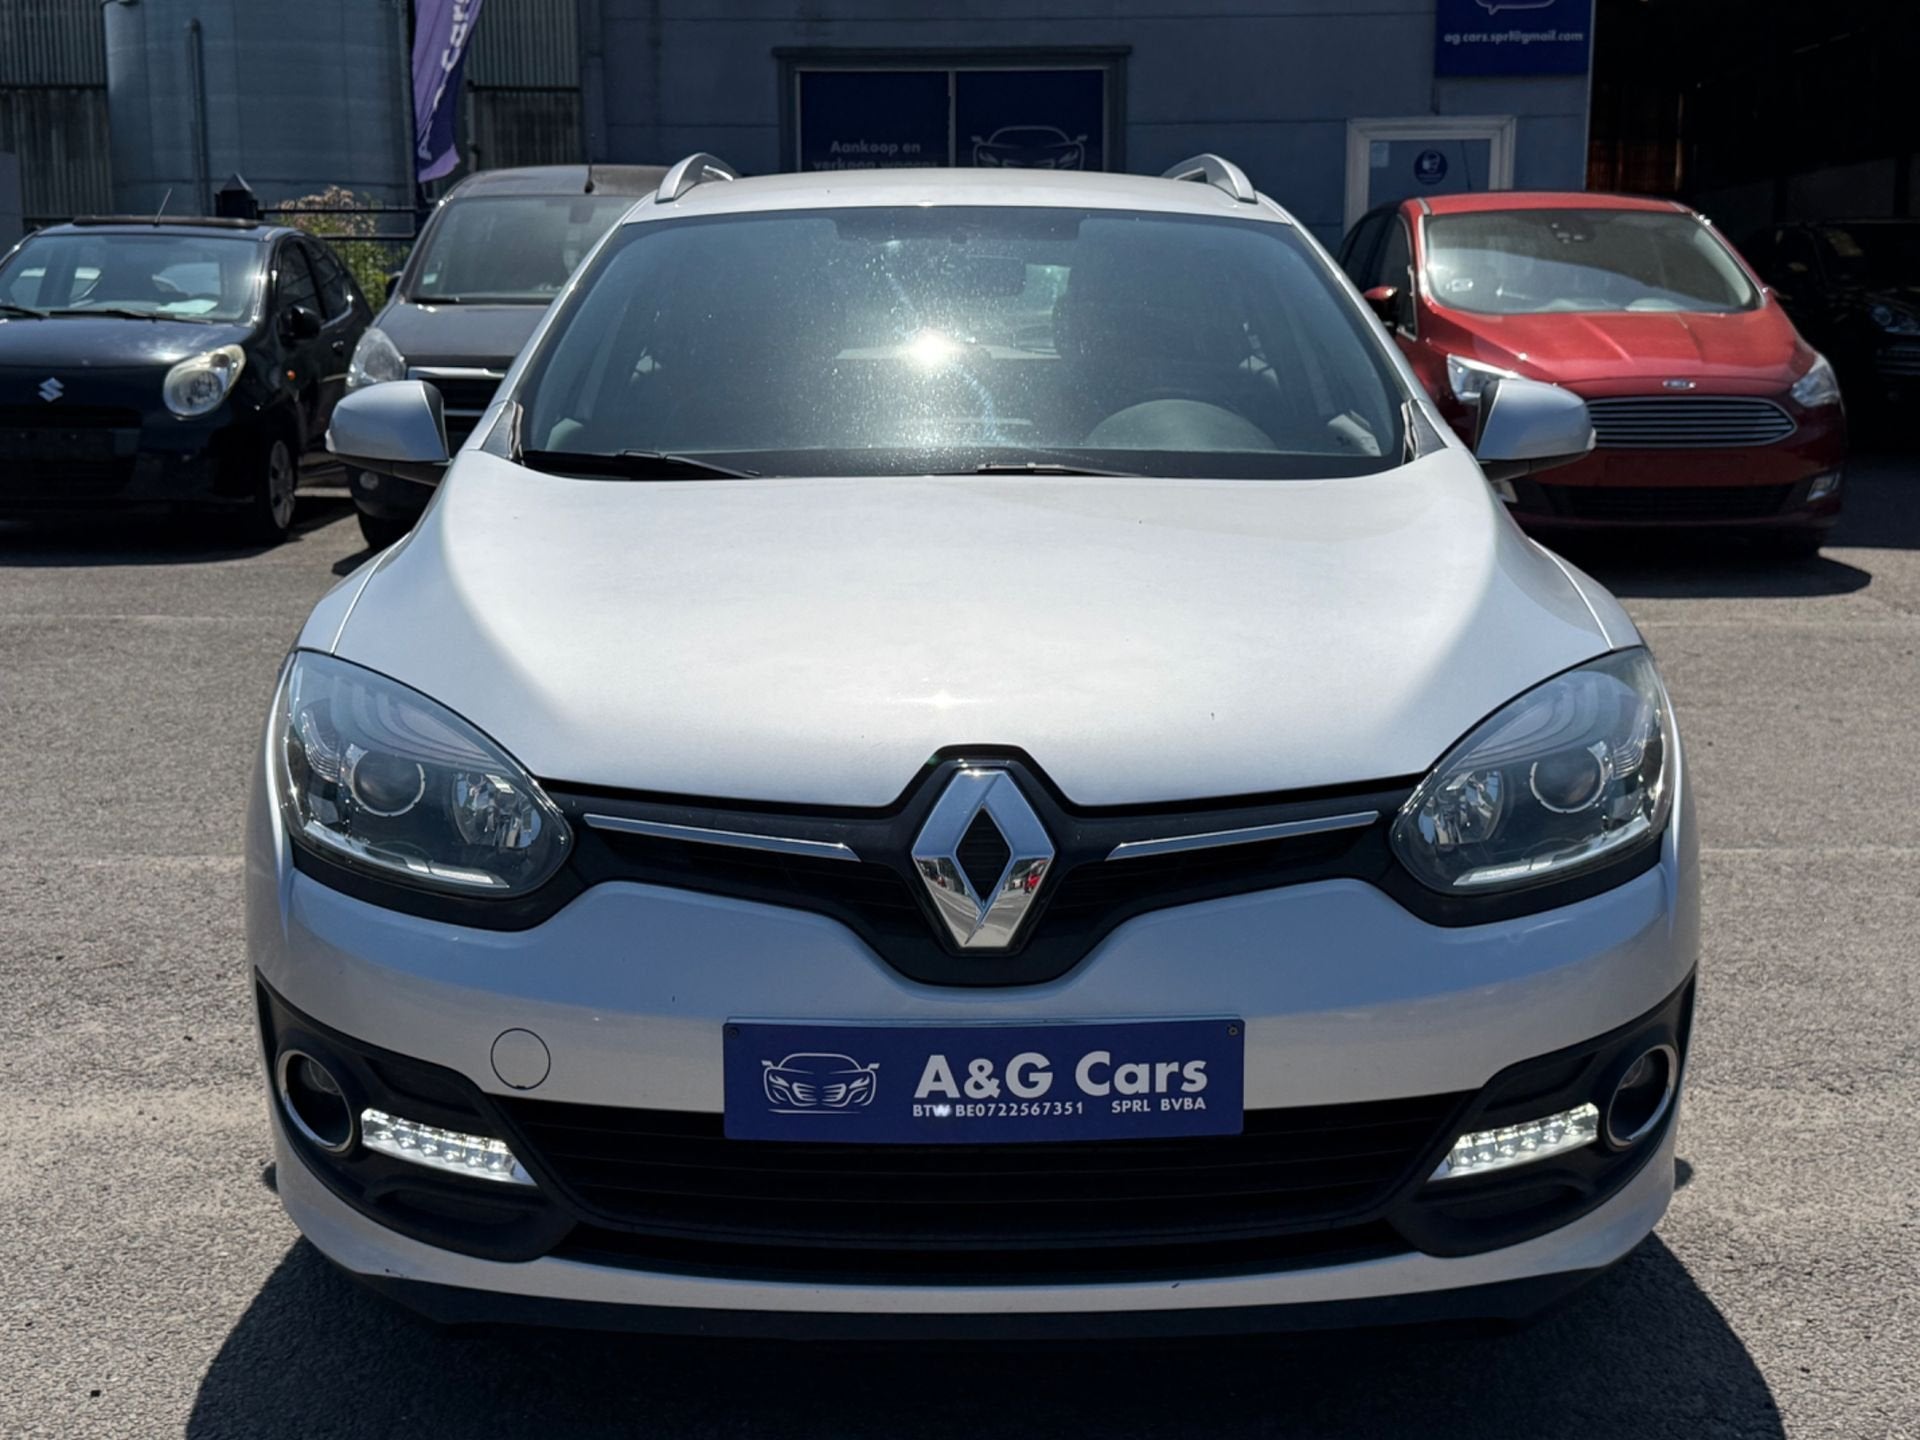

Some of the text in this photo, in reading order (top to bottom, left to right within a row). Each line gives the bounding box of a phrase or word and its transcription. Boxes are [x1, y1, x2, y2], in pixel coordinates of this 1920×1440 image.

[831, 140, 921, 156] Aankoop en
[914, 1050, 1208, 1099] A&G Cars
[913, 1097, 1206, 1117] BTW BE0722567351 SPRL BVBA
